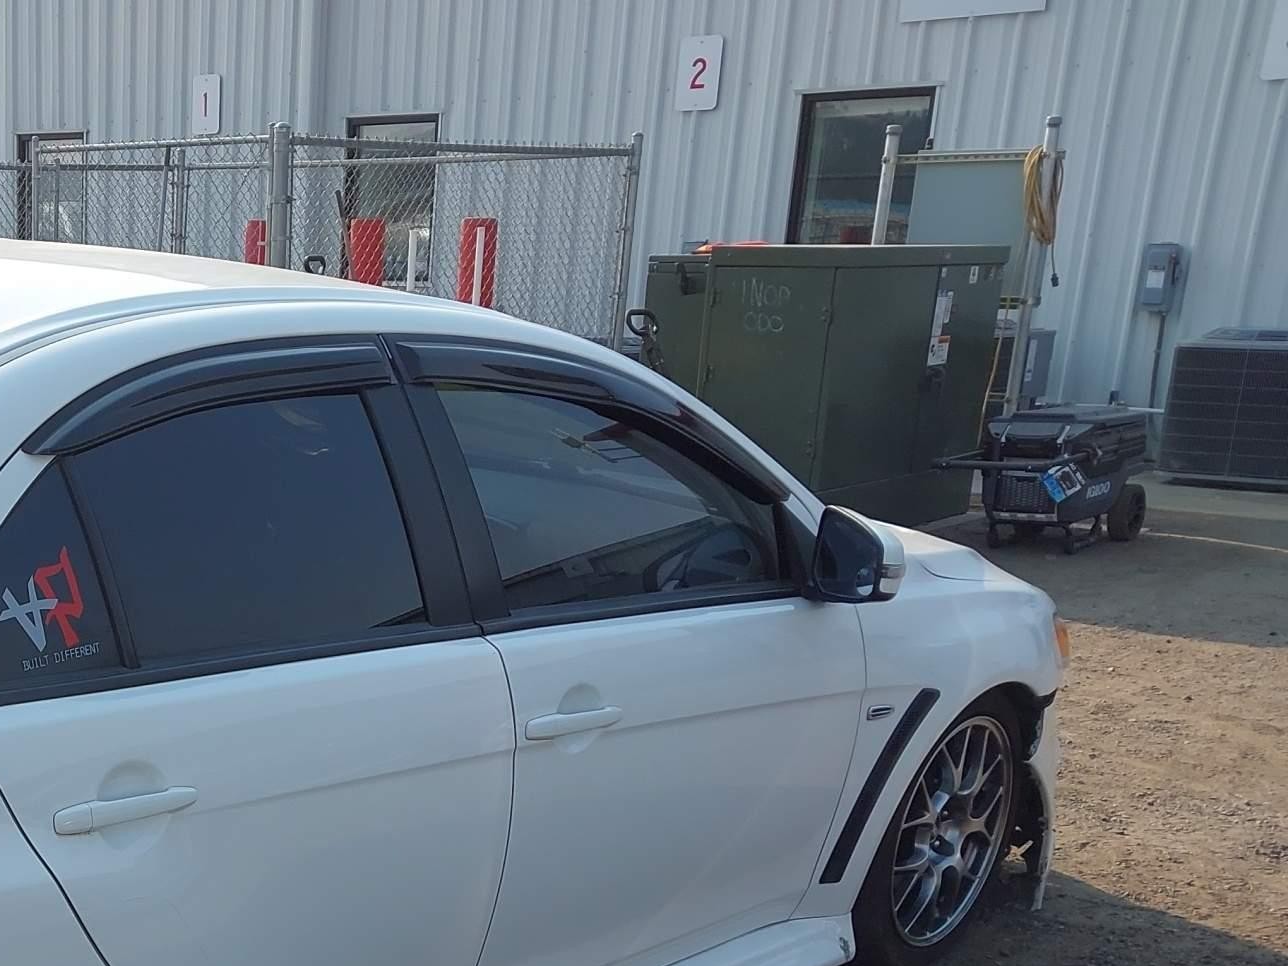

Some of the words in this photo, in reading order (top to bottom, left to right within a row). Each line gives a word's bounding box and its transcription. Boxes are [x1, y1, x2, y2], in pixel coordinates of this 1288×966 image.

[690, 57, 707, 90] 2
[202, 92, 208, 118] 1
[22, 655, 49, 672] BUILT
[54, 642, 100, 663] DIFFERENT
